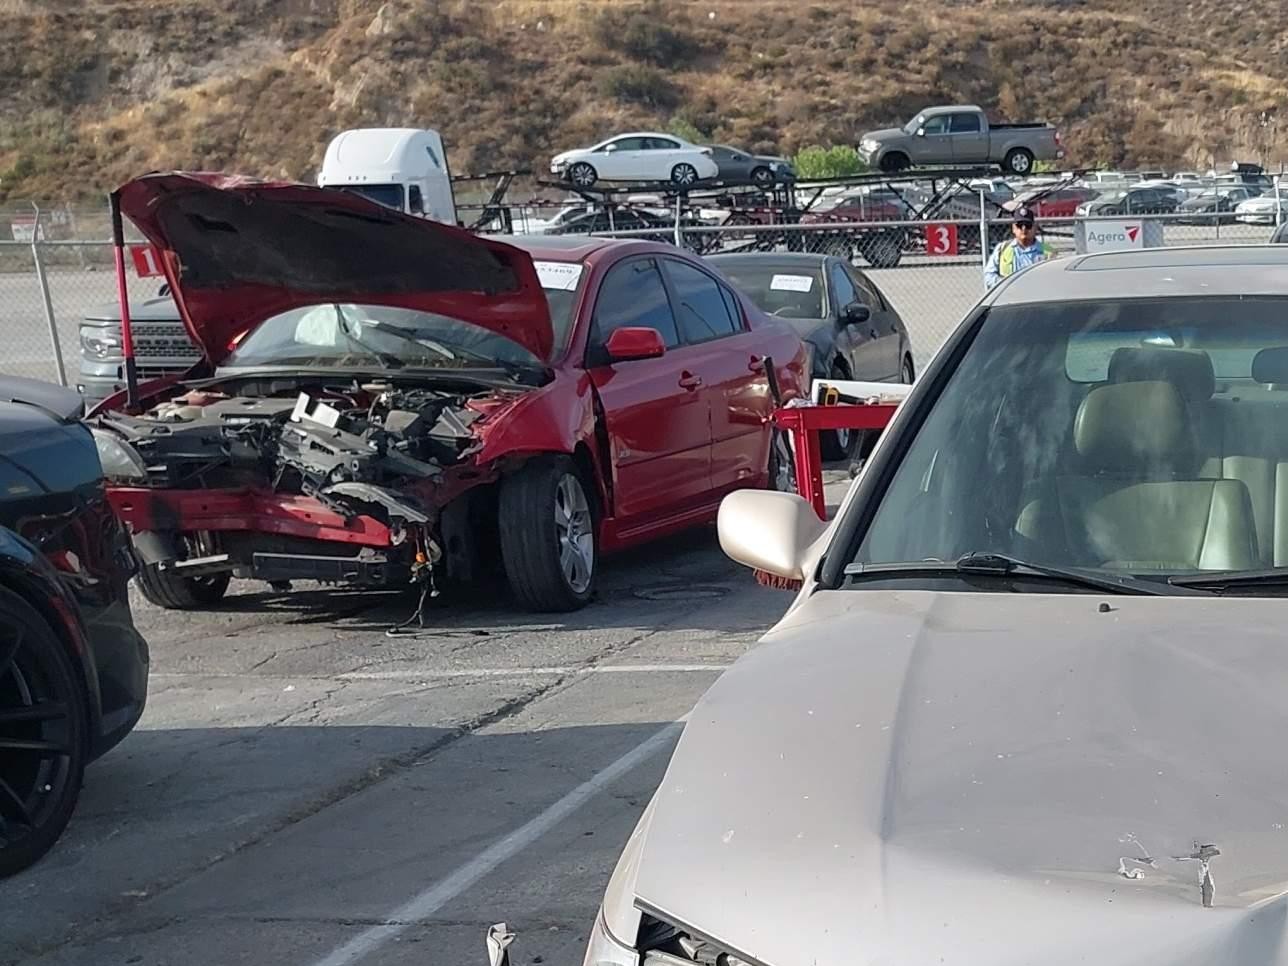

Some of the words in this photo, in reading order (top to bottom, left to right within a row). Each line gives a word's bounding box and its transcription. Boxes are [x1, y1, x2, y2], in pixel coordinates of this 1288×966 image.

[934, 226, 950, 253] 3
[1087, 230, 1125, 245] Agero
[141, 249, 158, 274] 1
